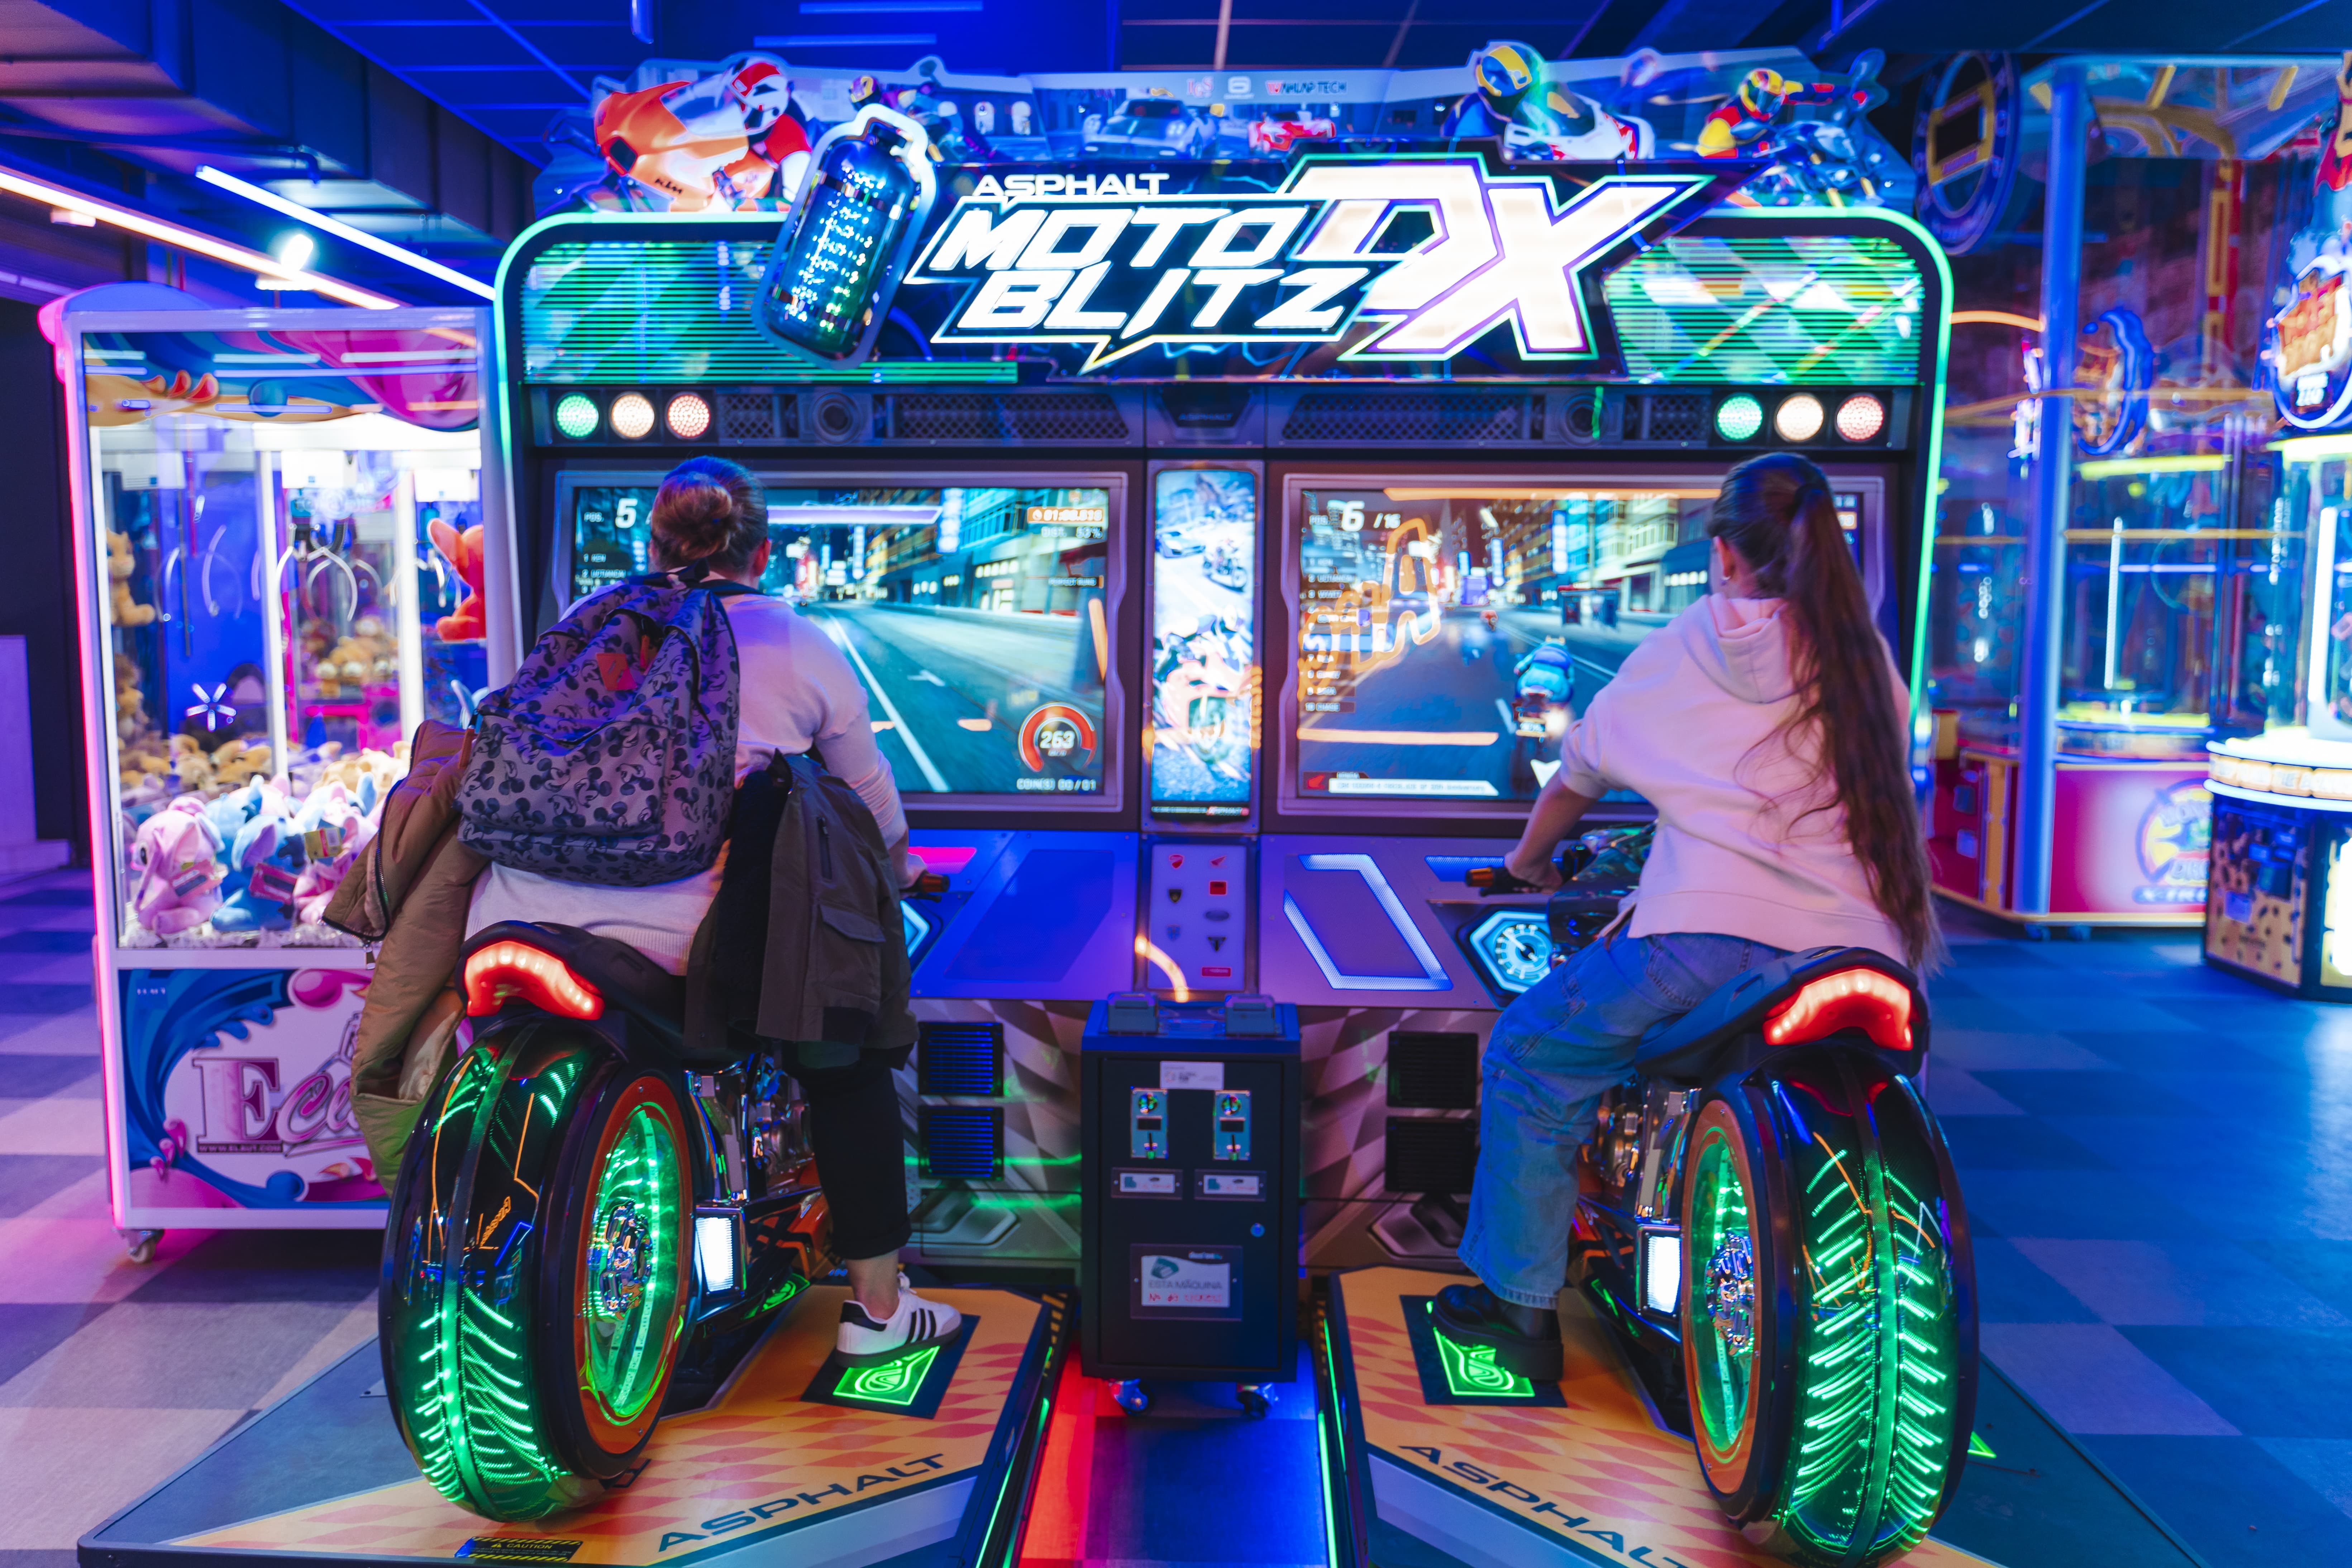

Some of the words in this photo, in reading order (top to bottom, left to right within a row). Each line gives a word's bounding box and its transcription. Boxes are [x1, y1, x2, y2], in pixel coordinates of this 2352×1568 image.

[972, 173, 1170, 196] ASPHALT
[928, 206, 1309, 271] MOTO
[1290, 159, 1692, 355] DX
[956, 260, 1370, 339] BLITZ
[615, 497, 638, 528] 5
[1341, 501, 1365, 532] 6
[1040, 731, 1075, 748] 263
[658, 1453, 944, 1552] ASPHALT
[1398, 1445, 1689, 1568] ASPHAL
